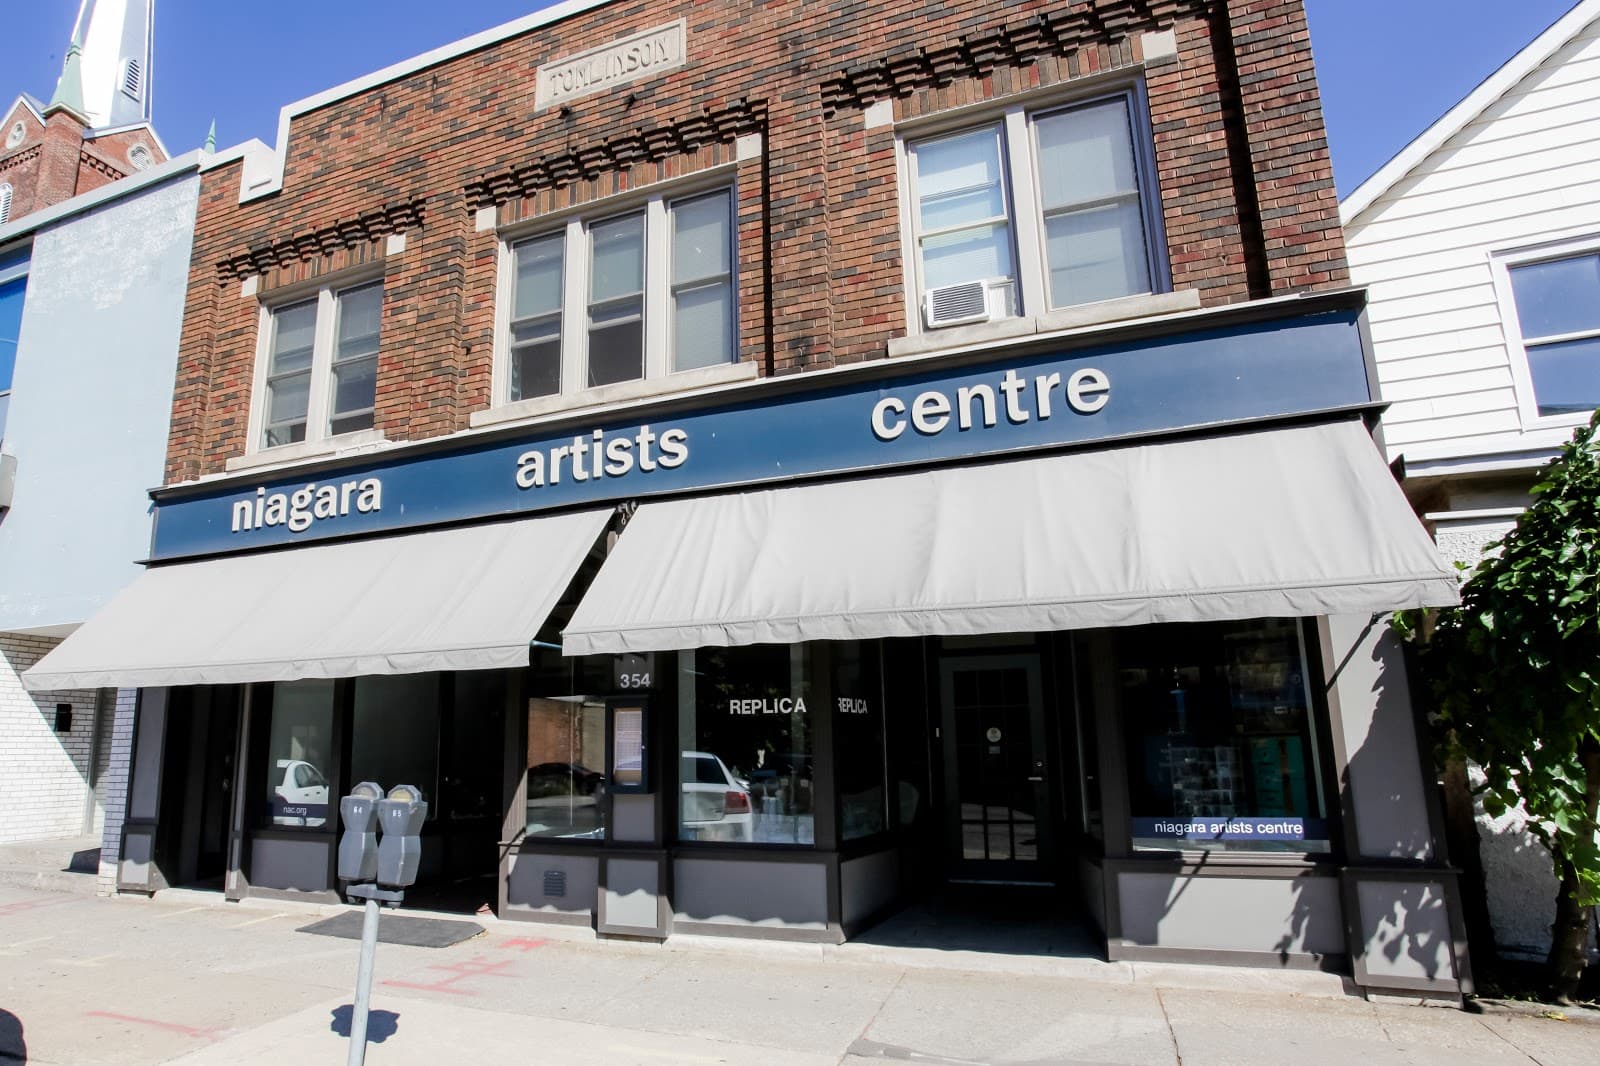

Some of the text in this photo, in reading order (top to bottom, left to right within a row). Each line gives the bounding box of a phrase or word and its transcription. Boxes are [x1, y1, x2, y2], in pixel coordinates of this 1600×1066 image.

[550, 36, 668, 96] TOMLINSON
[231, 367, 1111, 532] niagara artists centre
[619, 673, 651, 689] 354
[728, 697, 808, 715] REPLICA
[283, 806, 308, 817] nac.org
[1154, 820, 1303, 836] niagara artists centre
